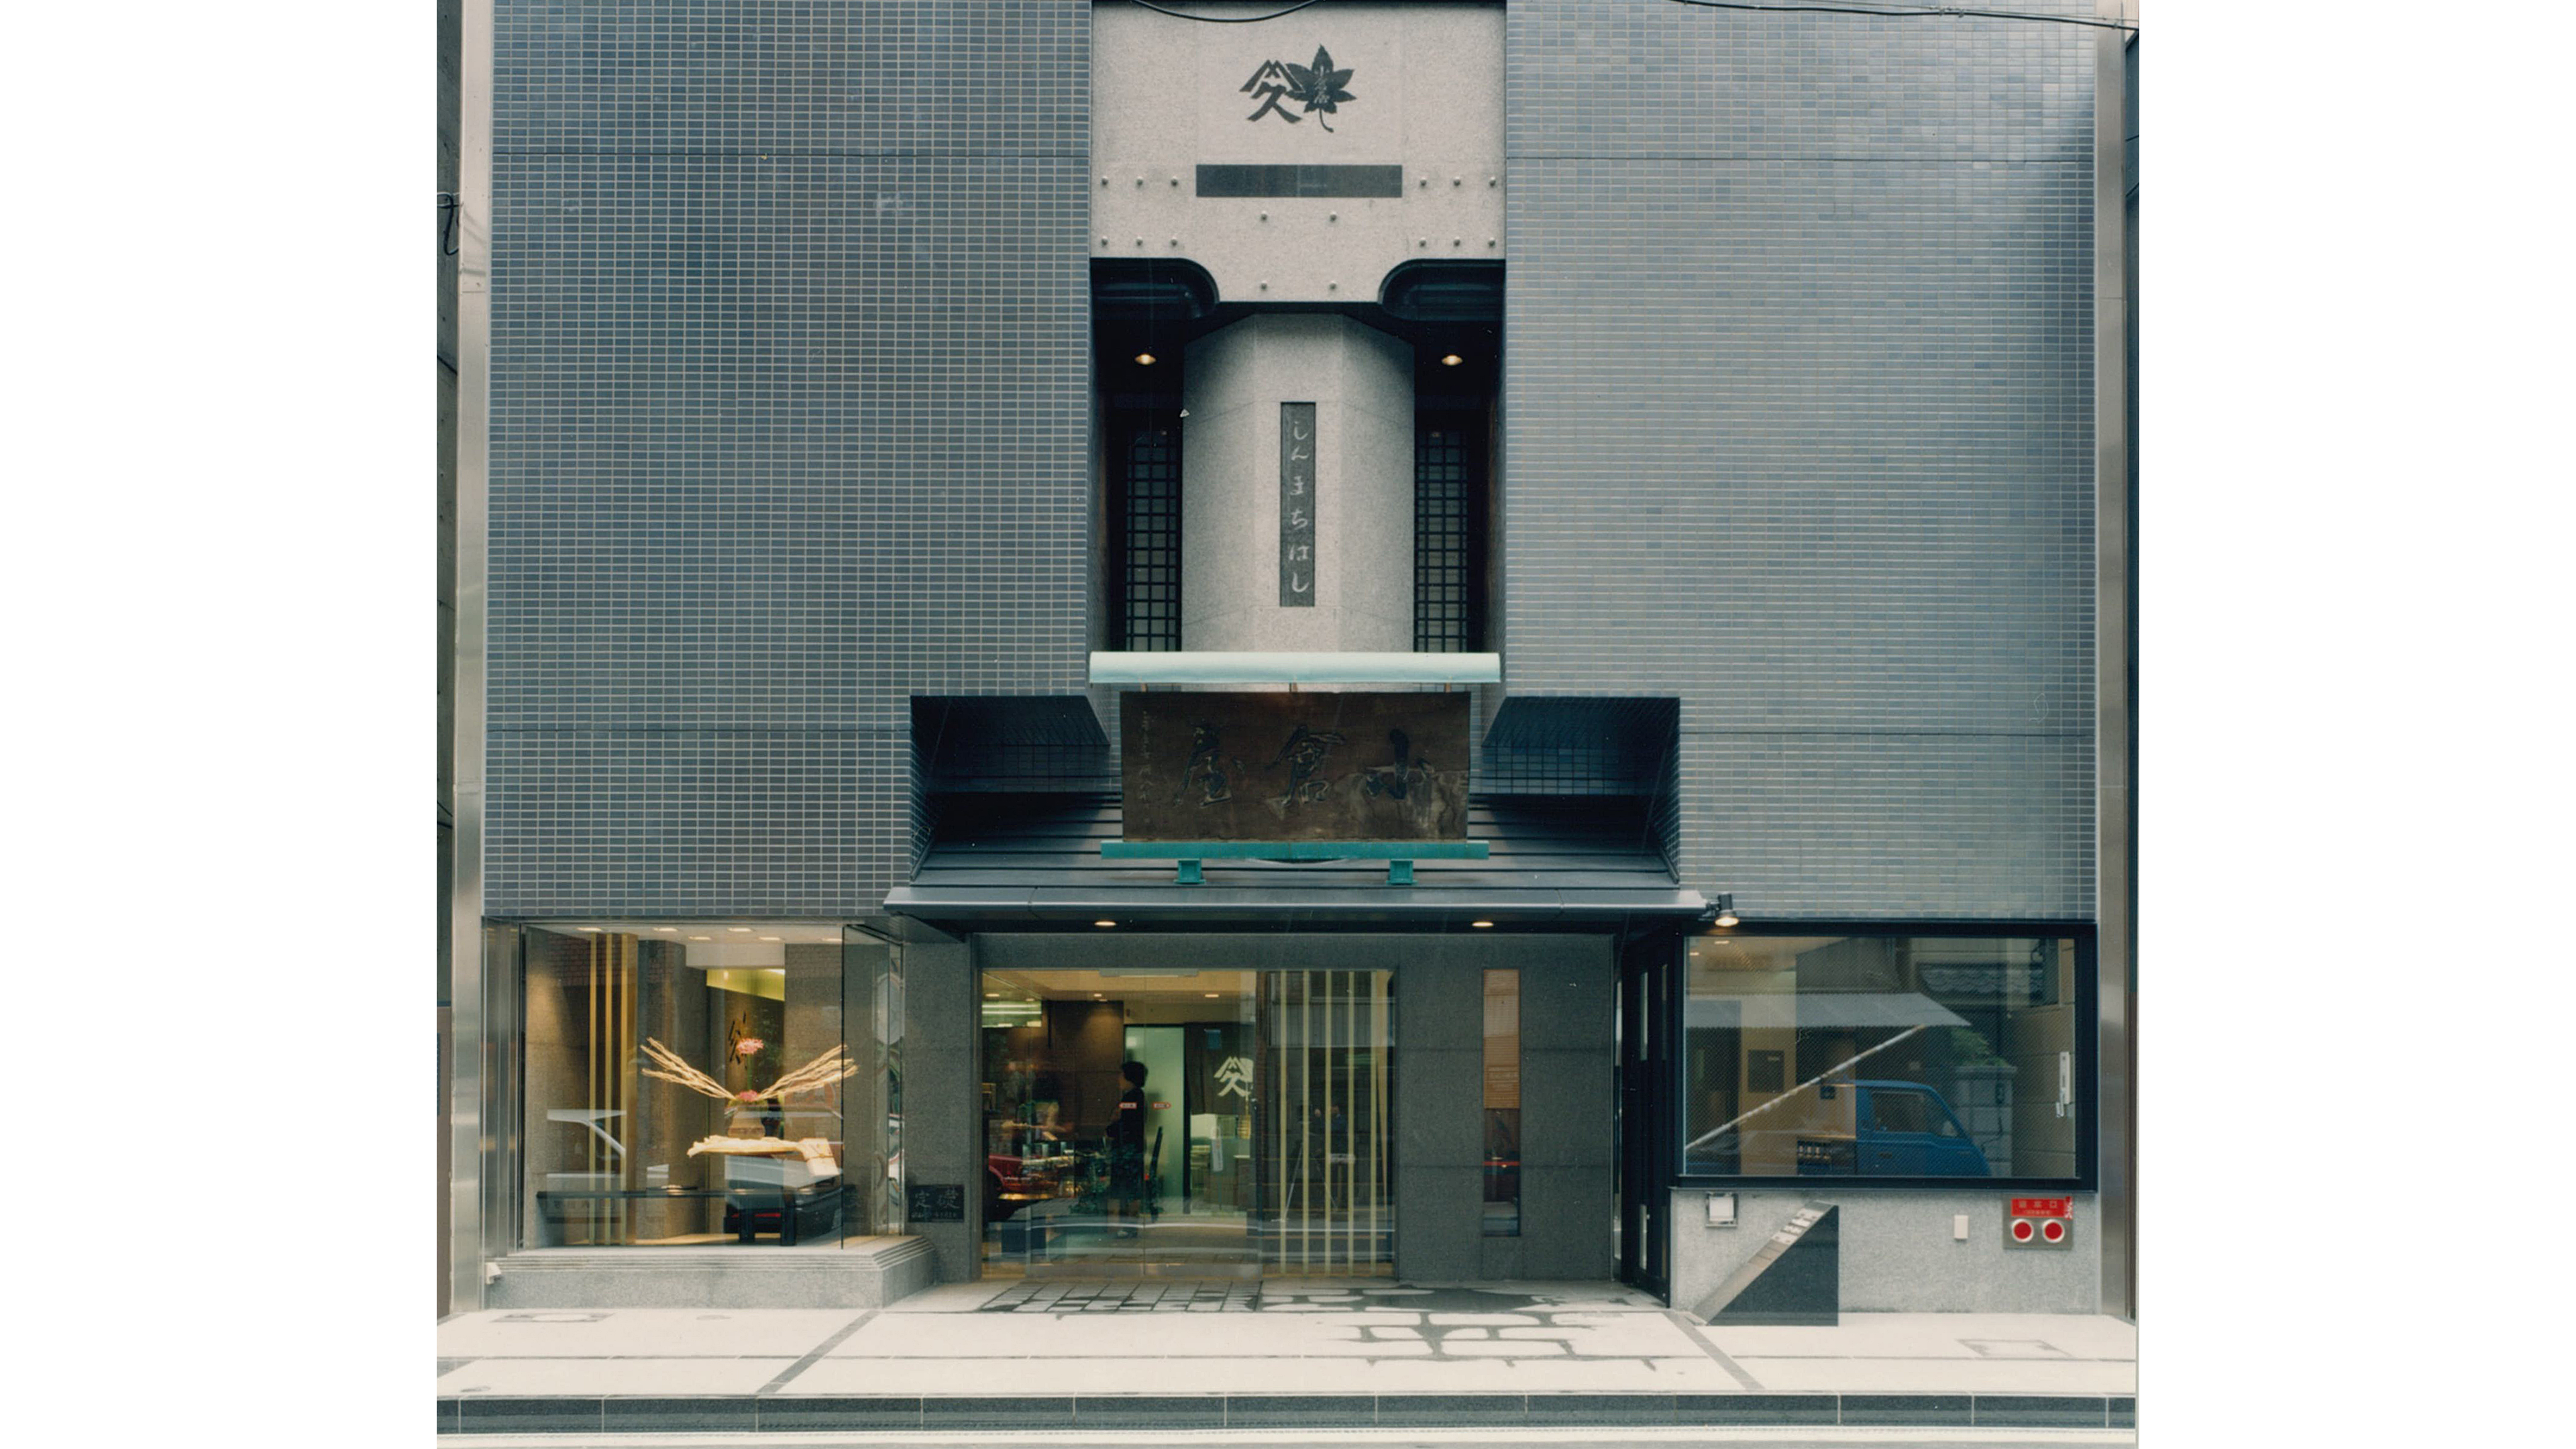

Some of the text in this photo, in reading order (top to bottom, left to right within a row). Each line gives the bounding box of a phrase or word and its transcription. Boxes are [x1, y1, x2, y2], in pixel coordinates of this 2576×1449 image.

[1289, 421, 1309, 593] しんまちはし
